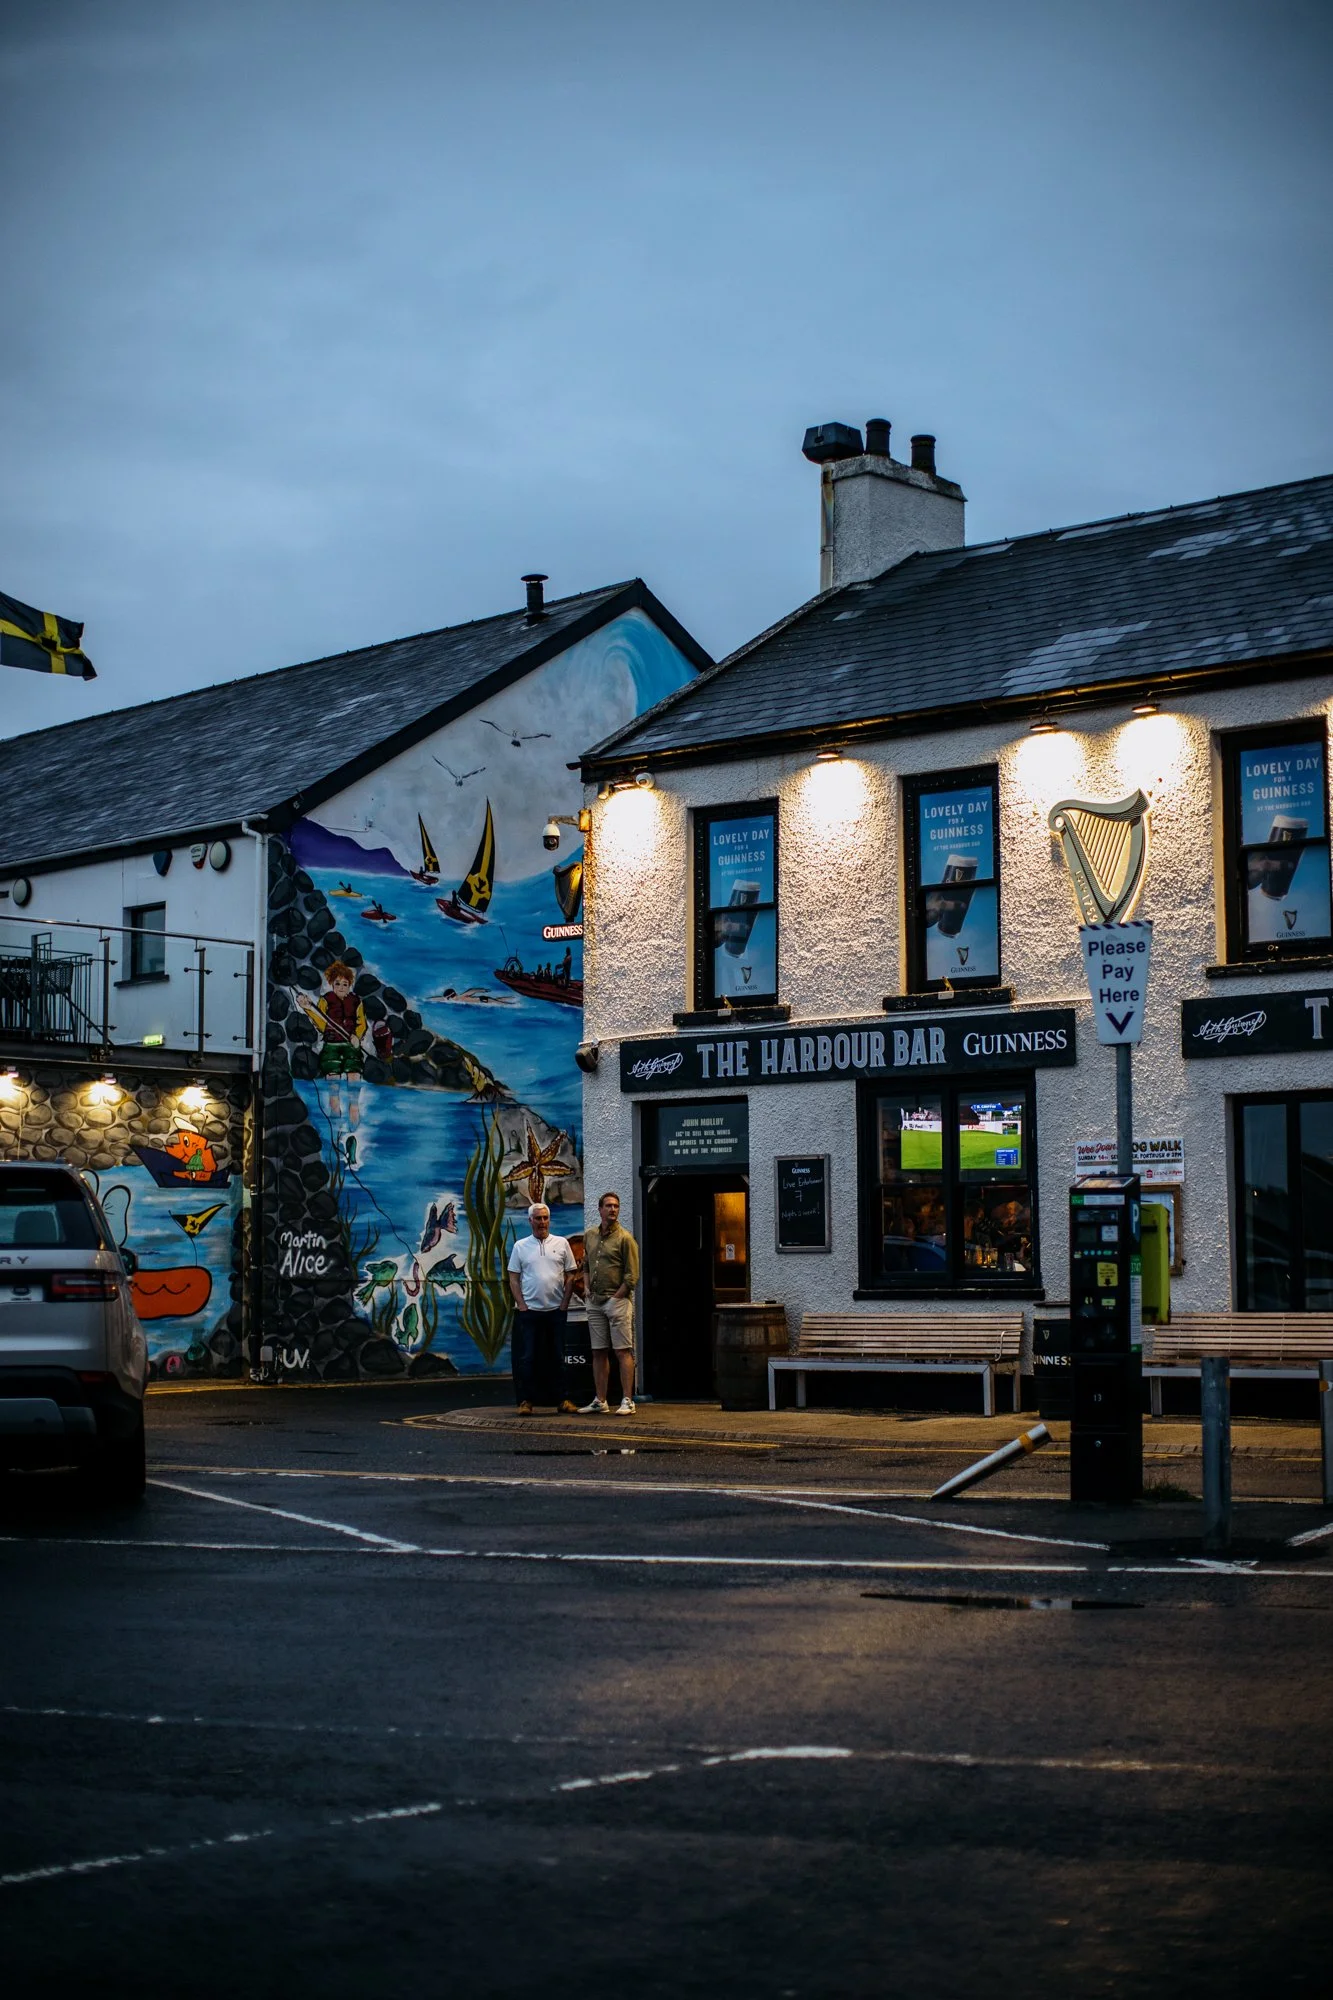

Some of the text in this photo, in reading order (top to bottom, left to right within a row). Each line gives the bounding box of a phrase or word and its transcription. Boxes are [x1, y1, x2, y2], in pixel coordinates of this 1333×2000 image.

[1246, 757, 1319, 777] LOVELY DAY
[1253, 782, 1314, 800] GUINNESS
[924, 801, 988, 819] LOVELY DAY
[713, 828, 770, 846] LOVELY DAY
[930, 824, 984, 840] GUINNESS
[718, 850, 766, 866] GUINNESS
[543, 925, 583, 939] GUINNESS
[1275, 930, 1306, 939] GUINNESS
[1087, 941, 1146, 957] Please
[951, 965, 978, 974] GUINNESS
[1101, 963, 1135, 981] Pay
[1099, 988, 1140, 1004] Here
[1304, 997, 1333, 1040] T
[963, 1029, 1067, 1057] GUINNESS
[697, 1027, 947, 1079] THE HARBOUR BAR
[682, 1117, 724, 1127] JOHN MOLLOY
[1150, 1140, 1182, 1152] WALK
[794, 1190, 802, 1202] 7
[1132, 1203, 1140, 1235] P
[280, 1230, 327, 1250] Martin
[280, 1249, 334, 1277] Alice
[1093, 1393, 1102, 1402] 13
